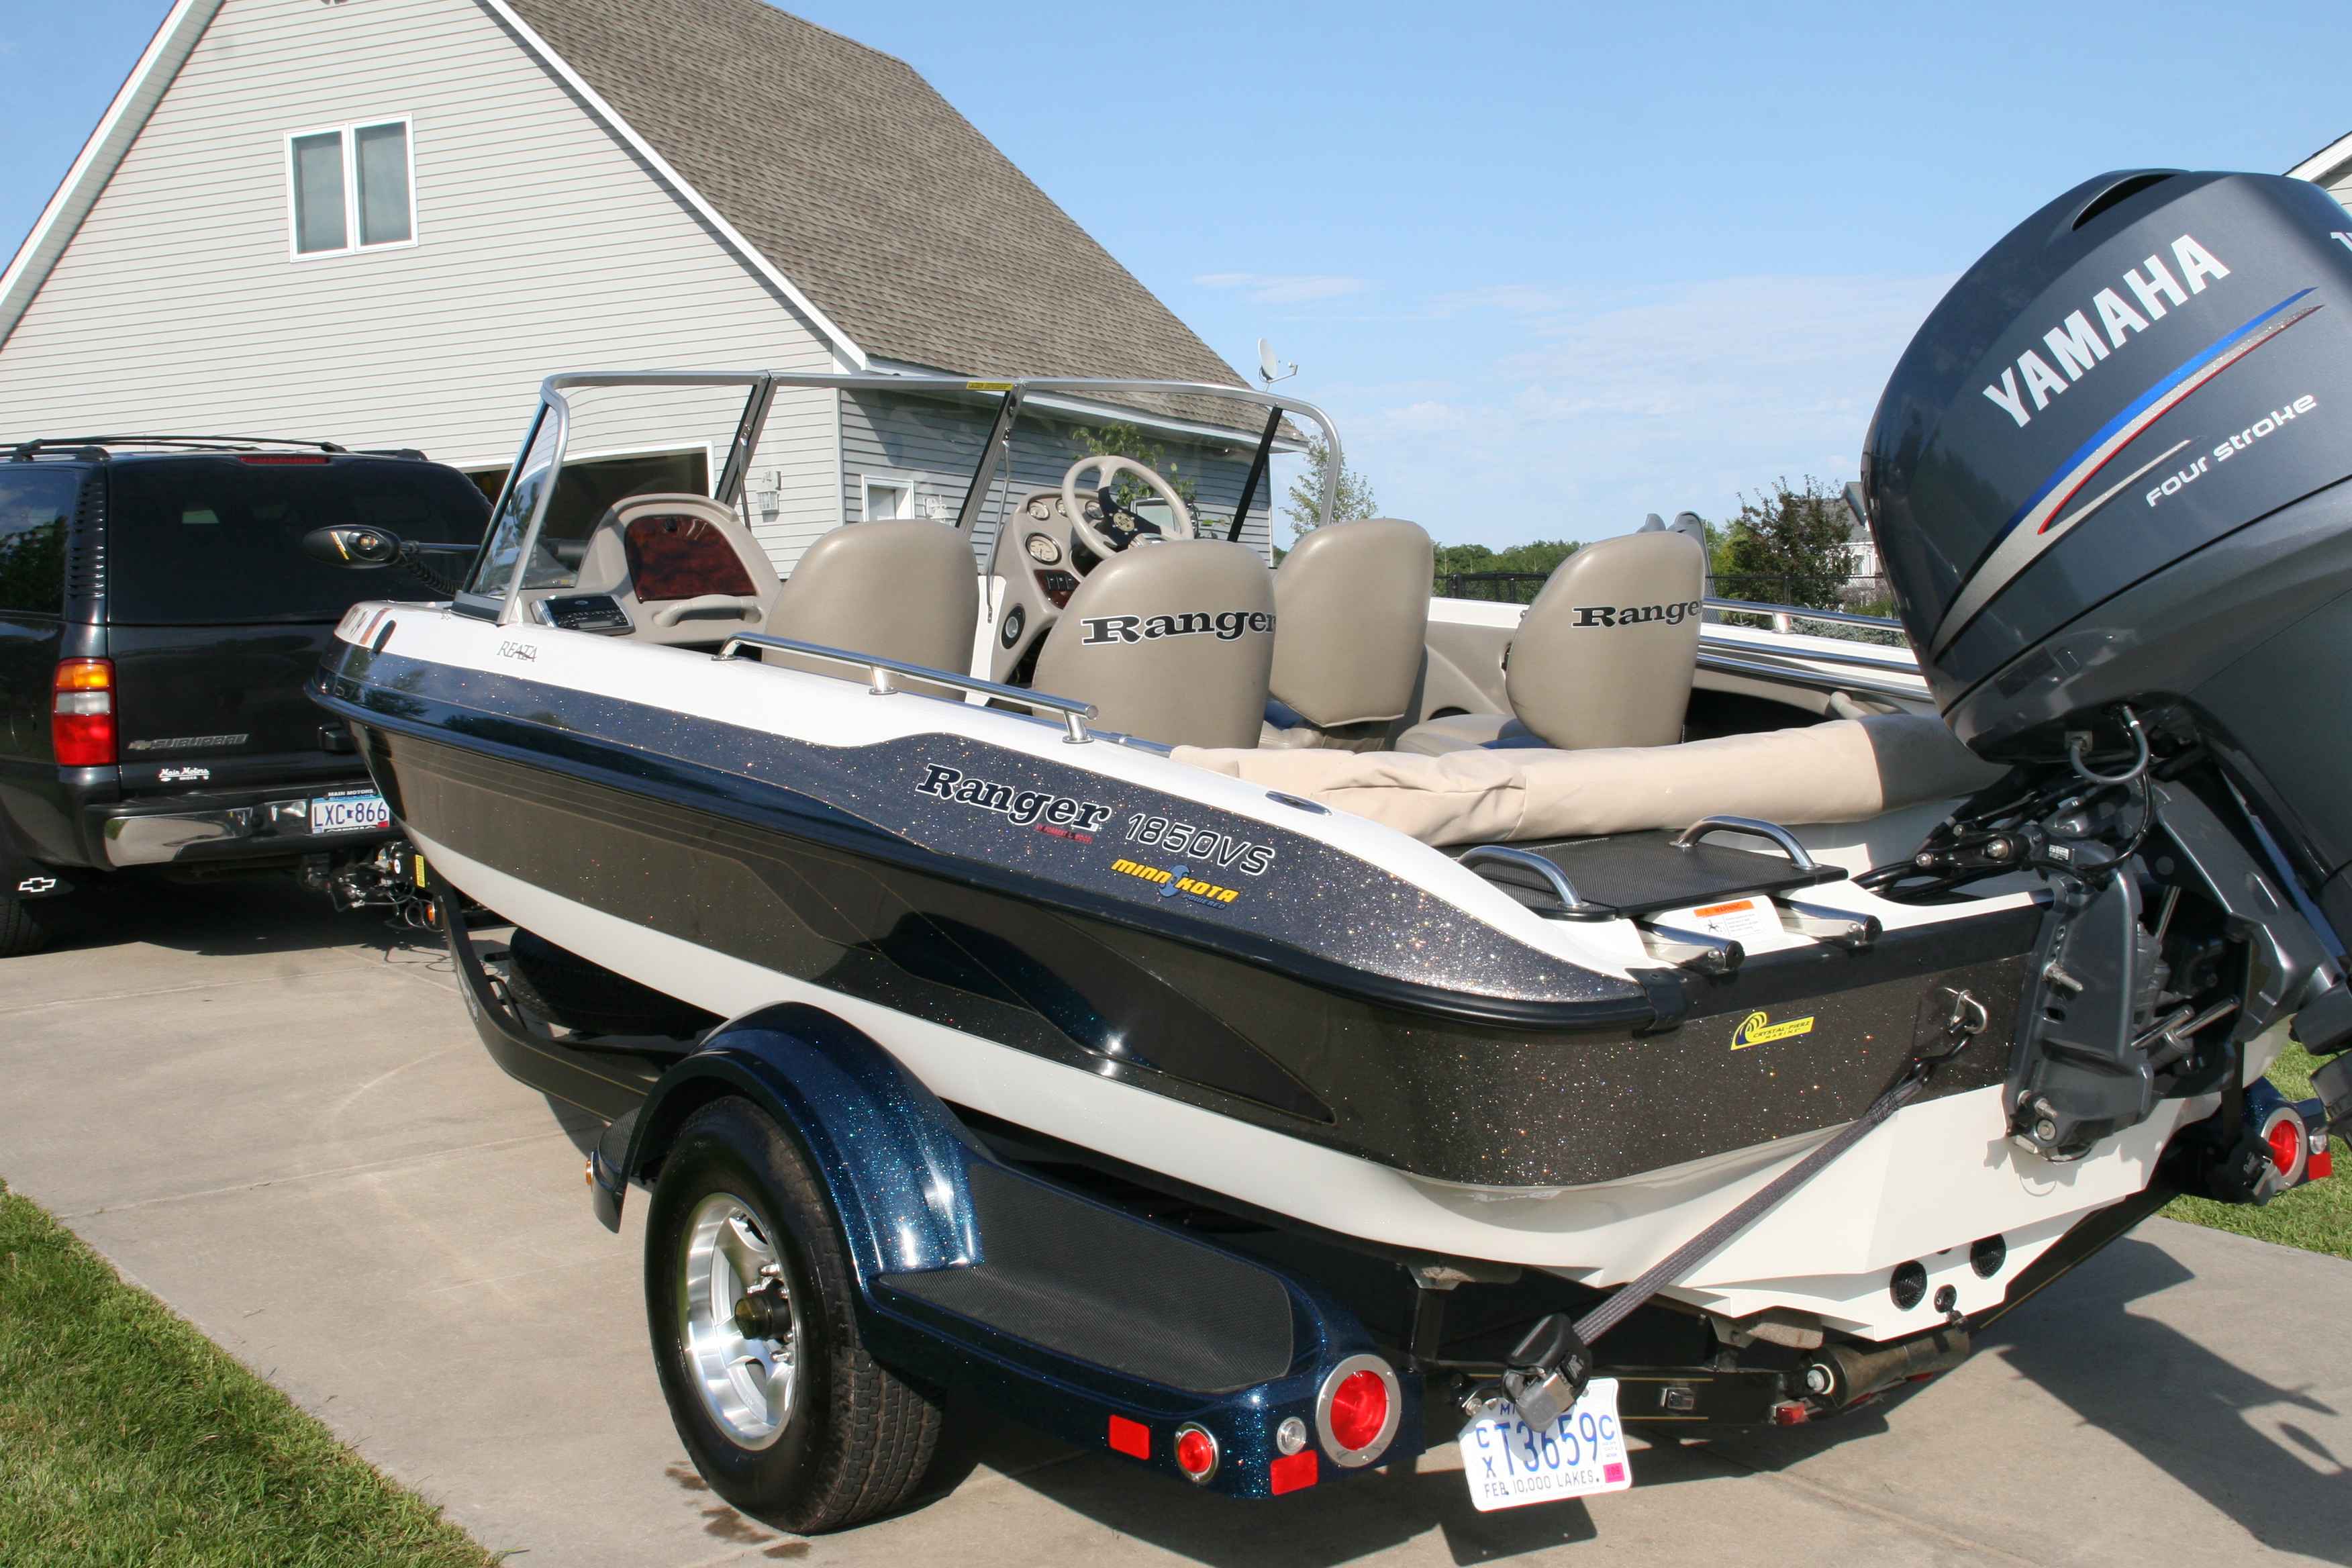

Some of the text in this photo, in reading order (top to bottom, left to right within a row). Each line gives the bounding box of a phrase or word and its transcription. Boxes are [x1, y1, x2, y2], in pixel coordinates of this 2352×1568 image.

[1983, 234, 2231, 428] YAMAHA
[1080, 611, 1276, 646] Ranger
[497, 640, 538, 663] REATA
[915, 763, 1112, 832] Ranger
[313, 802, 387, 826] LXC 866
[1126, 813, 1275, 876] 1850VS
[1175, 877, 1240, 903] KOTA
[1184, 893, 1227, 910] POWERED
[1512, 1475, 1552, 1495] 10,000
